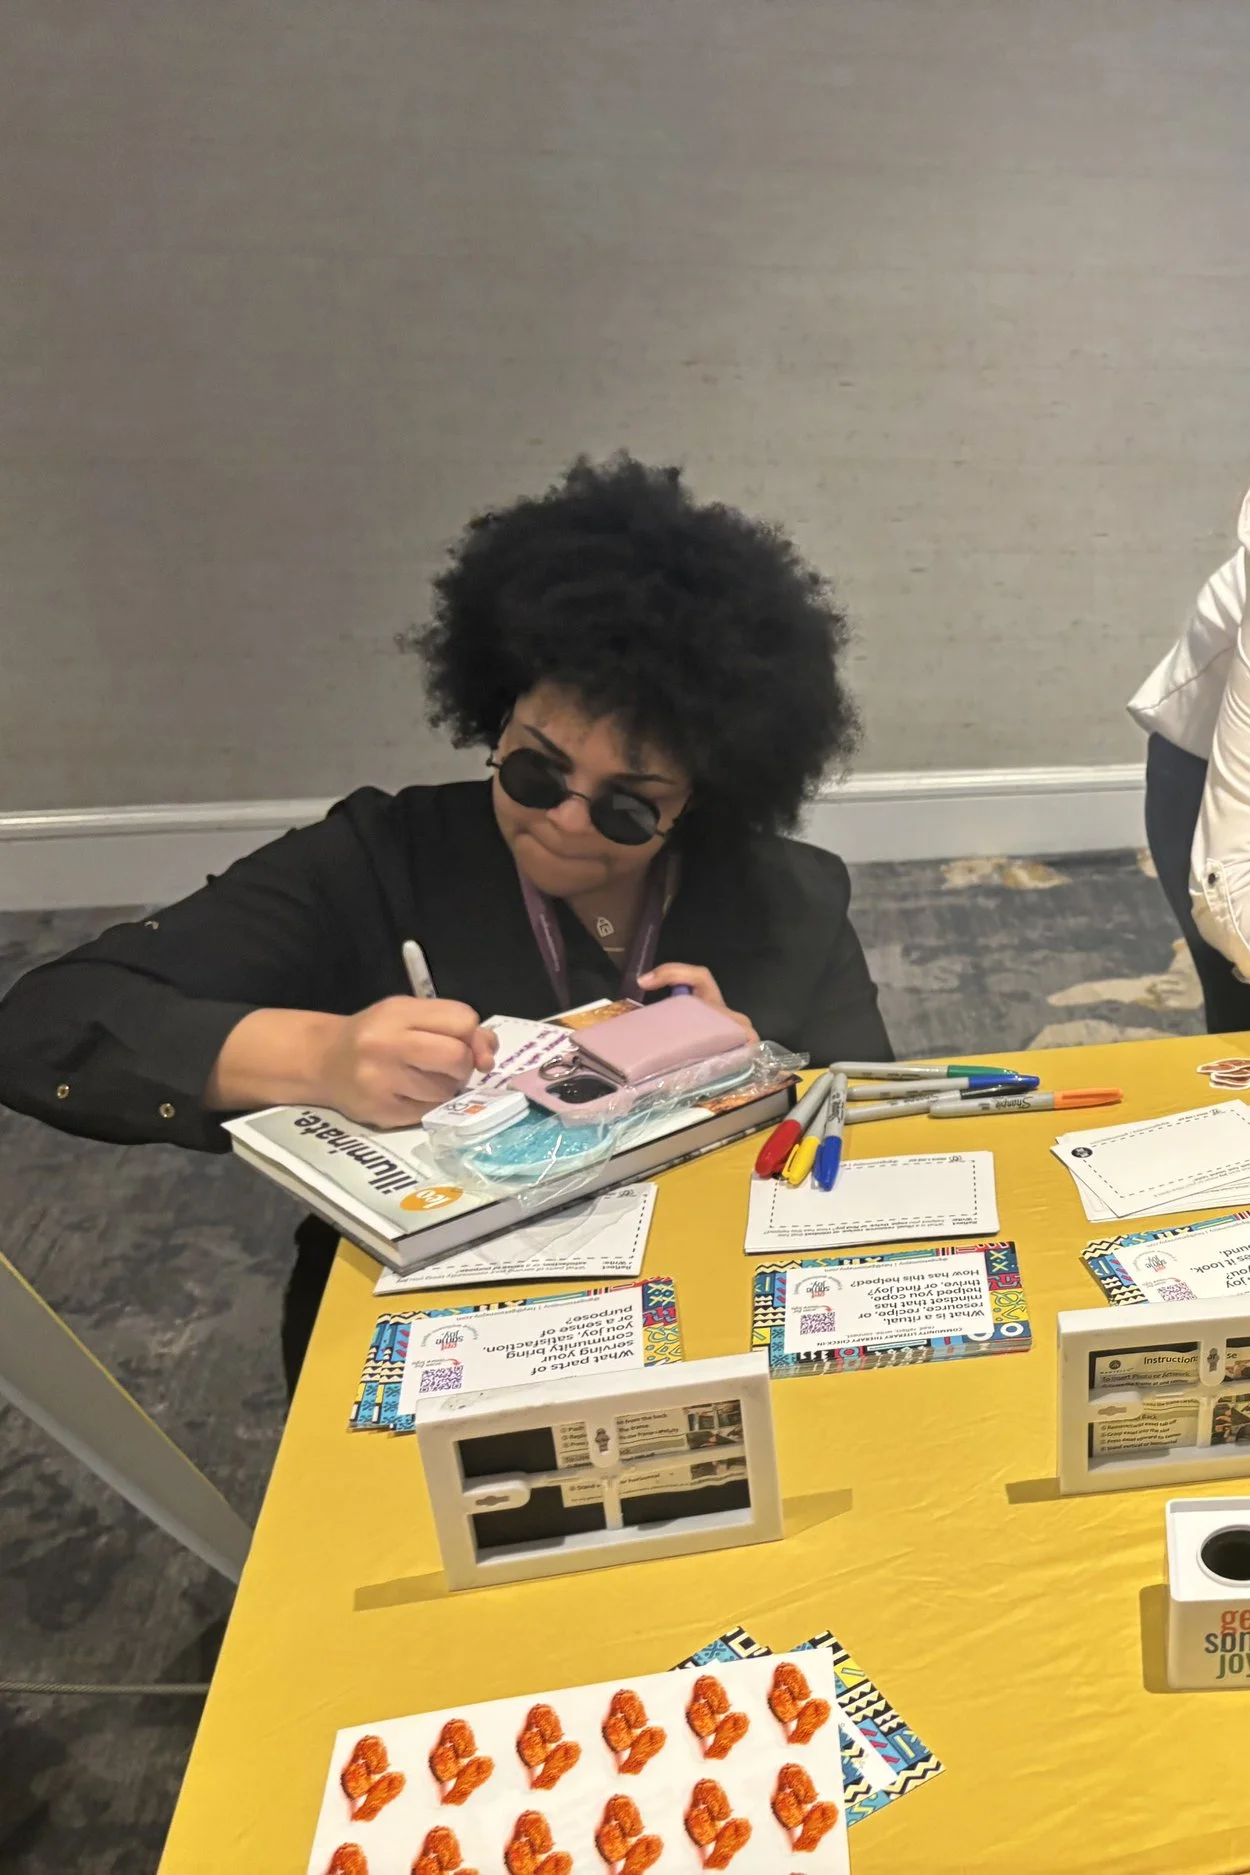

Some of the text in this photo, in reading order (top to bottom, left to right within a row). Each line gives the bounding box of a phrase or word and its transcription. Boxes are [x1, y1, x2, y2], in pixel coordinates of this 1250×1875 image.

[1189, 1260, 1225, 1274] look,
[1223, 1257, 1237, 1266] it
[849, 1268, 980, 1288] How has this helped?
[866, 1278, 981, 1296] thrive, or find joy?
[1225, 1275, 1247, 1289] joy
[869, 1286, 982, 1302] helped you cope,
[873, 1293, 983, 1310] mindset that has
[564, 1304, 633, 1325] purpose?
[857, 1301, 983, 1319] resource, recipe, or
[934, 1311, 946, 1320] is
[948, 1309, 985, 1319] What
[539, 1313, 633, 1338] or a sense of
[882, 1314, 921, 1325] ritual,
[482, 1320, 633, 1353] you joy, satisfaction,
[505, 1330, 633, 1359] community bring
[540, 1338, 634, 1363] serving your
[529, 1348, 634, 1376] What parts of
